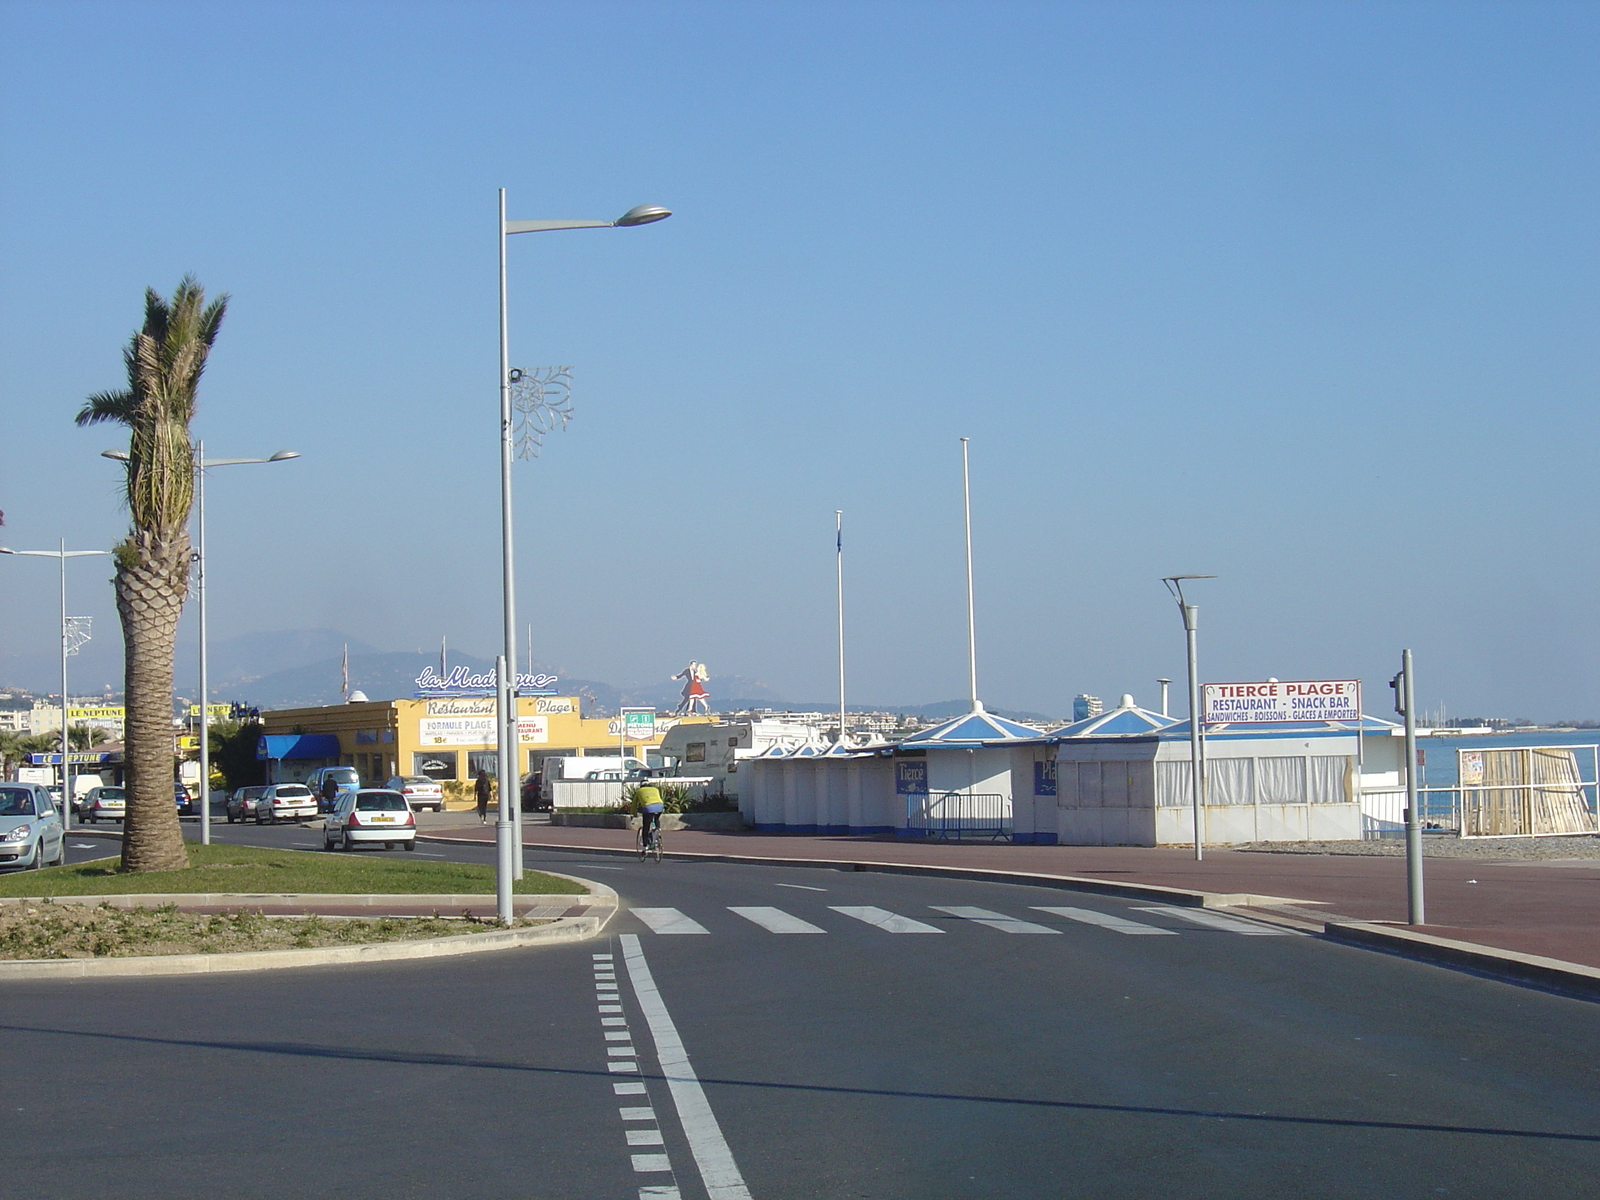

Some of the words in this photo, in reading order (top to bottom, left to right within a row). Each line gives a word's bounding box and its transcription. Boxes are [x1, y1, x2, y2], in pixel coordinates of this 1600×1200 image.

[415, 665, 440, 688] la
[1219, 683, 1278, 697] TIERCÉ
[1286, 683, 1343, 696] PLAGE
[427, 701, 494, 715] Restaurant
[537, 700, 570, 714] Plage
[1212, 698, 1277, 711] RESTAURANT
[1291, 697, 1326, 709] SNACK
[1329, 696, 1350, 708] BAR
[84, 709, 122, 717] NEPTUNE
[1207, 712, 1248, 722] SANDWICHES
[1254, 710, 1287, 720] BOISSONS
[1292, 709, 1316, 720] GLACES
[1324, 709, 1357, 719] EMPORTER
[427, 721, 462, 730] FORMULE
[465, 720, 492, 730] PLAGE
[42, 755, 53, 763] LE
[61, 753, 101, 762] EPTUNE
[899, 763, 924, 781] Tiercé
[1042, 761, 1056, 780] Pla
